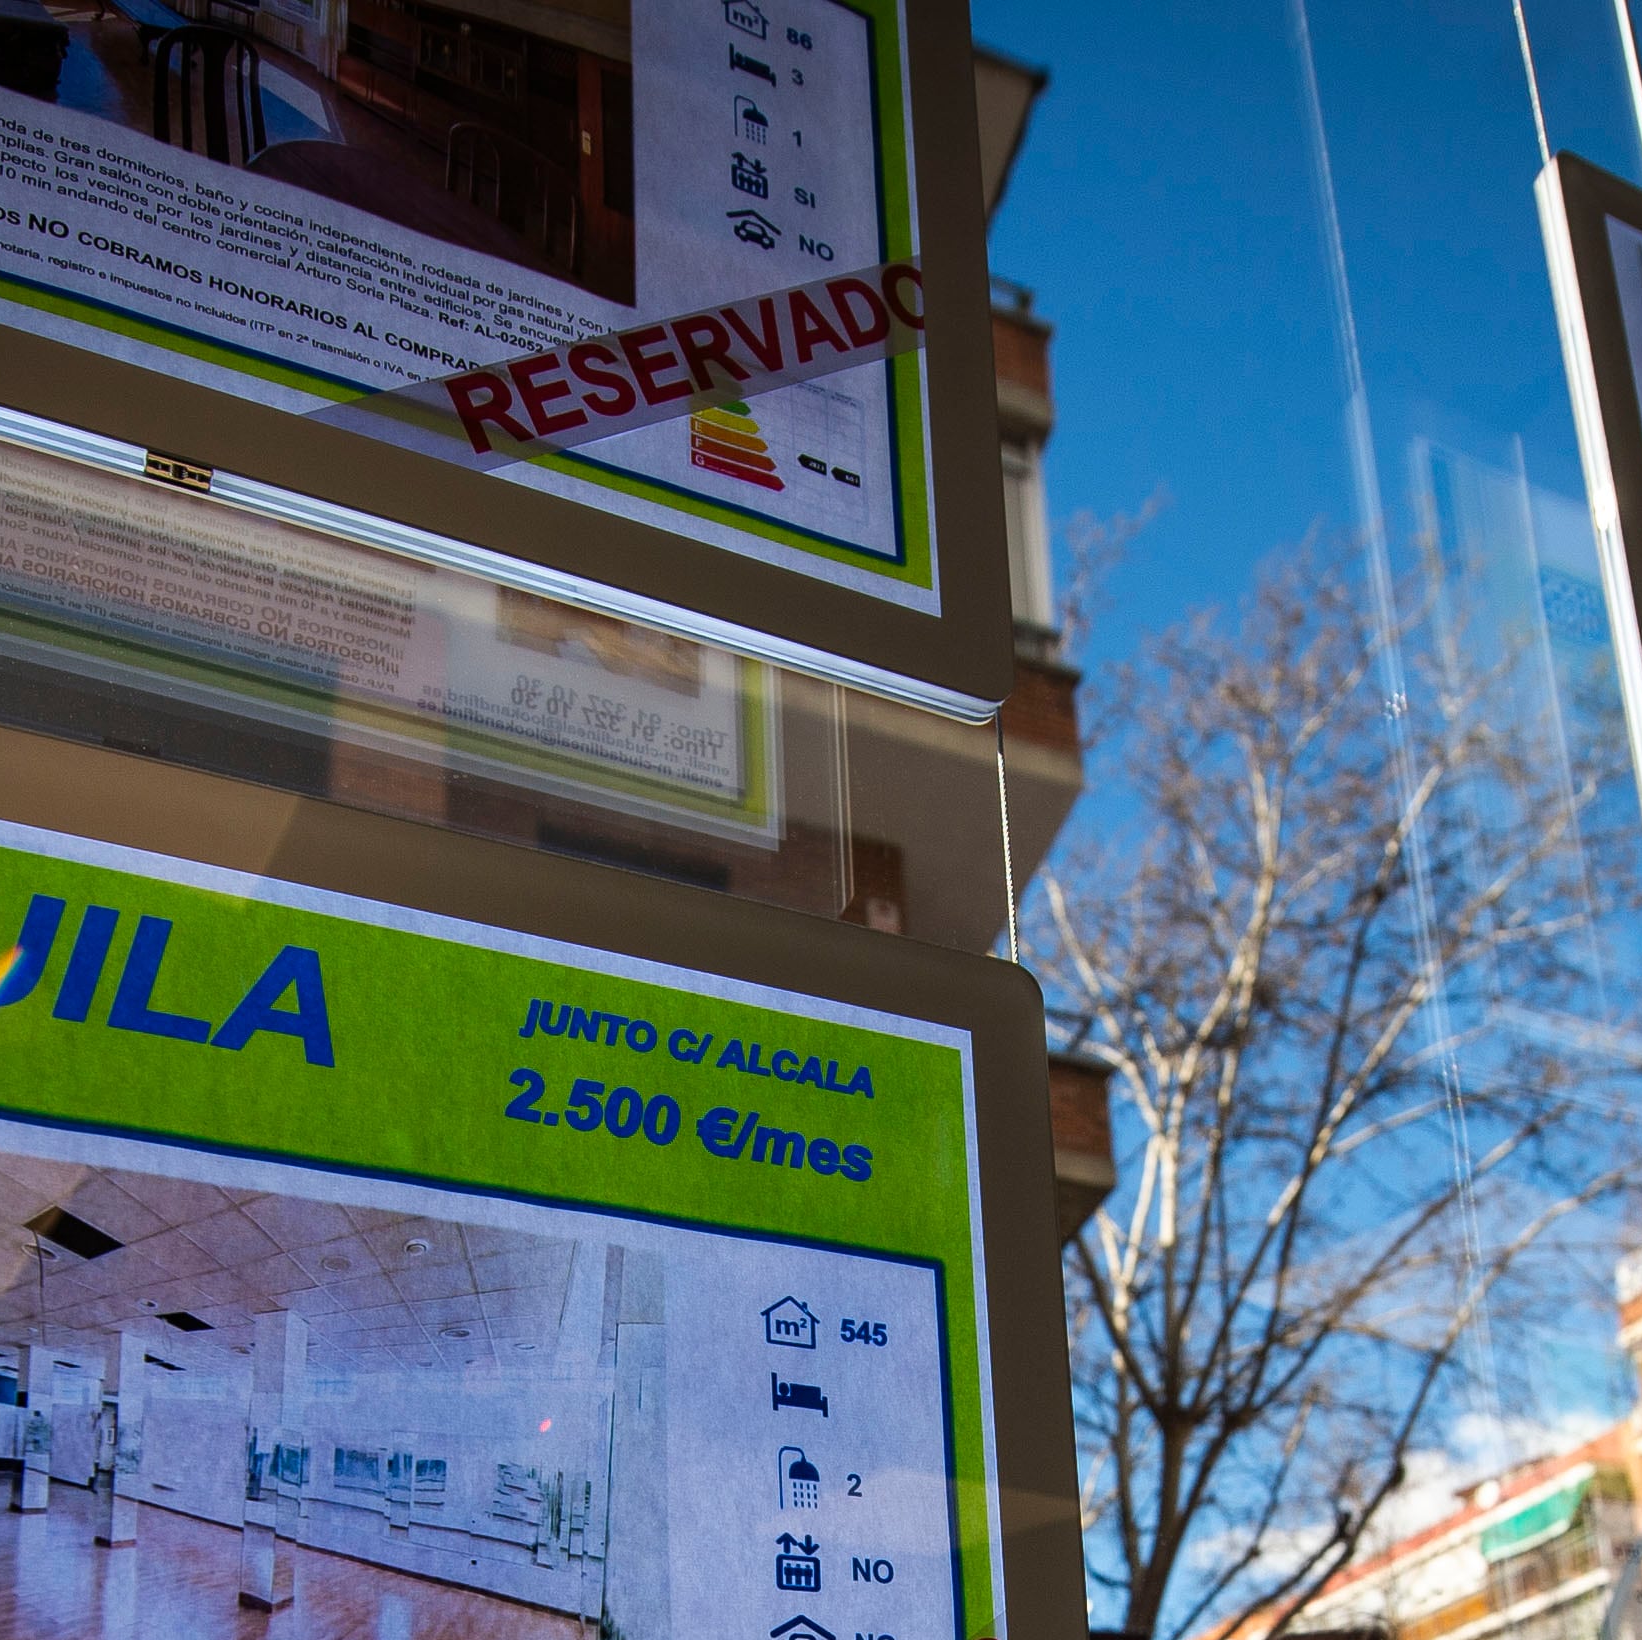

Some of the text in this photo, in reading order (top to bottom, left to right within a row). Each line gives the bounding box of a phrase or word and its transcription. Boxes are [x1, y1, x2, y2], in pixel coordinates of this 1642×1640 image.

[785, 26, 813, 51] 86
[790, 67, 804, 87] 3
[791, 130, 803, 148] 1
[794, 187, 817, 209] SI
[32, 129, 54, 144] de
[60, 136, 91, 155] tres
[96, 147, 185, 189] dormitorios,
[195, 182, 234, 205] baño
[239, 199, 249, 211] y
[253, 204, 304, 228] cocina
[309, 219, 416, 270] independiente,
[421, 263, 481, 290] rodeada
[485, 282, 504, 297] de
[507, 288, 563, 318] jardines
[566, 311, 575, 324] y
[578, 317, 603, 334] con
[798, 234, 835, 263] NO
[28, 213, 70, 239] NO
[77, 231, 203, 284] COBRAMOS
[209, 275, 348, 330] HONORARIOS
[353, 321, 379, 341] AL
[445, 263, 924, 454] RESERVADO
[518, 998, 876, 1100] JUNTO C/ ALCALA
[504, 1066, 875, 1183] 2.500 €/mes
[839, 1317, 890, 1349] 545
[845, 1472, 863, 1499] 2
[851, 1558, 896, 1586] NO
